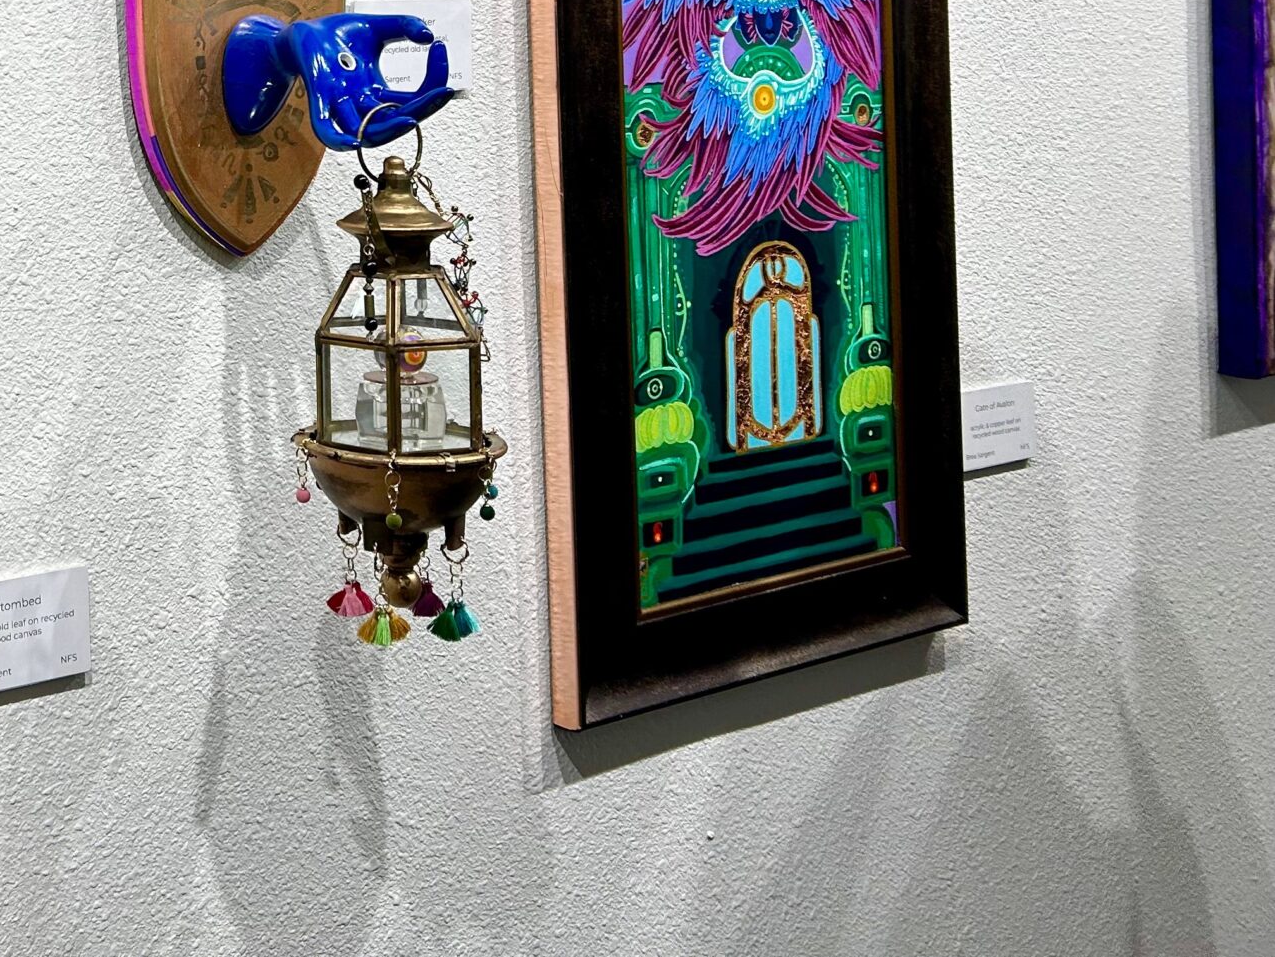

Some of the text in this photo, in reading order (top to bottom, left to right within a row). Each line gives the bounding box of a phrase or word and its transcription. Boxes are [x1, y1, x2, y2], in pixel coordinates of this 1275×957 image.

[384, 45, 409, 55] ecycled
[385, 75, 411, 83] Sargent
[11, 617, 27, 629] leaf
[28, 616, 39, 626] on
[40, 608, 75, 624] recycled
[13, 628, 43, 640] canvas
[60, 653, 78, 664] NFS
